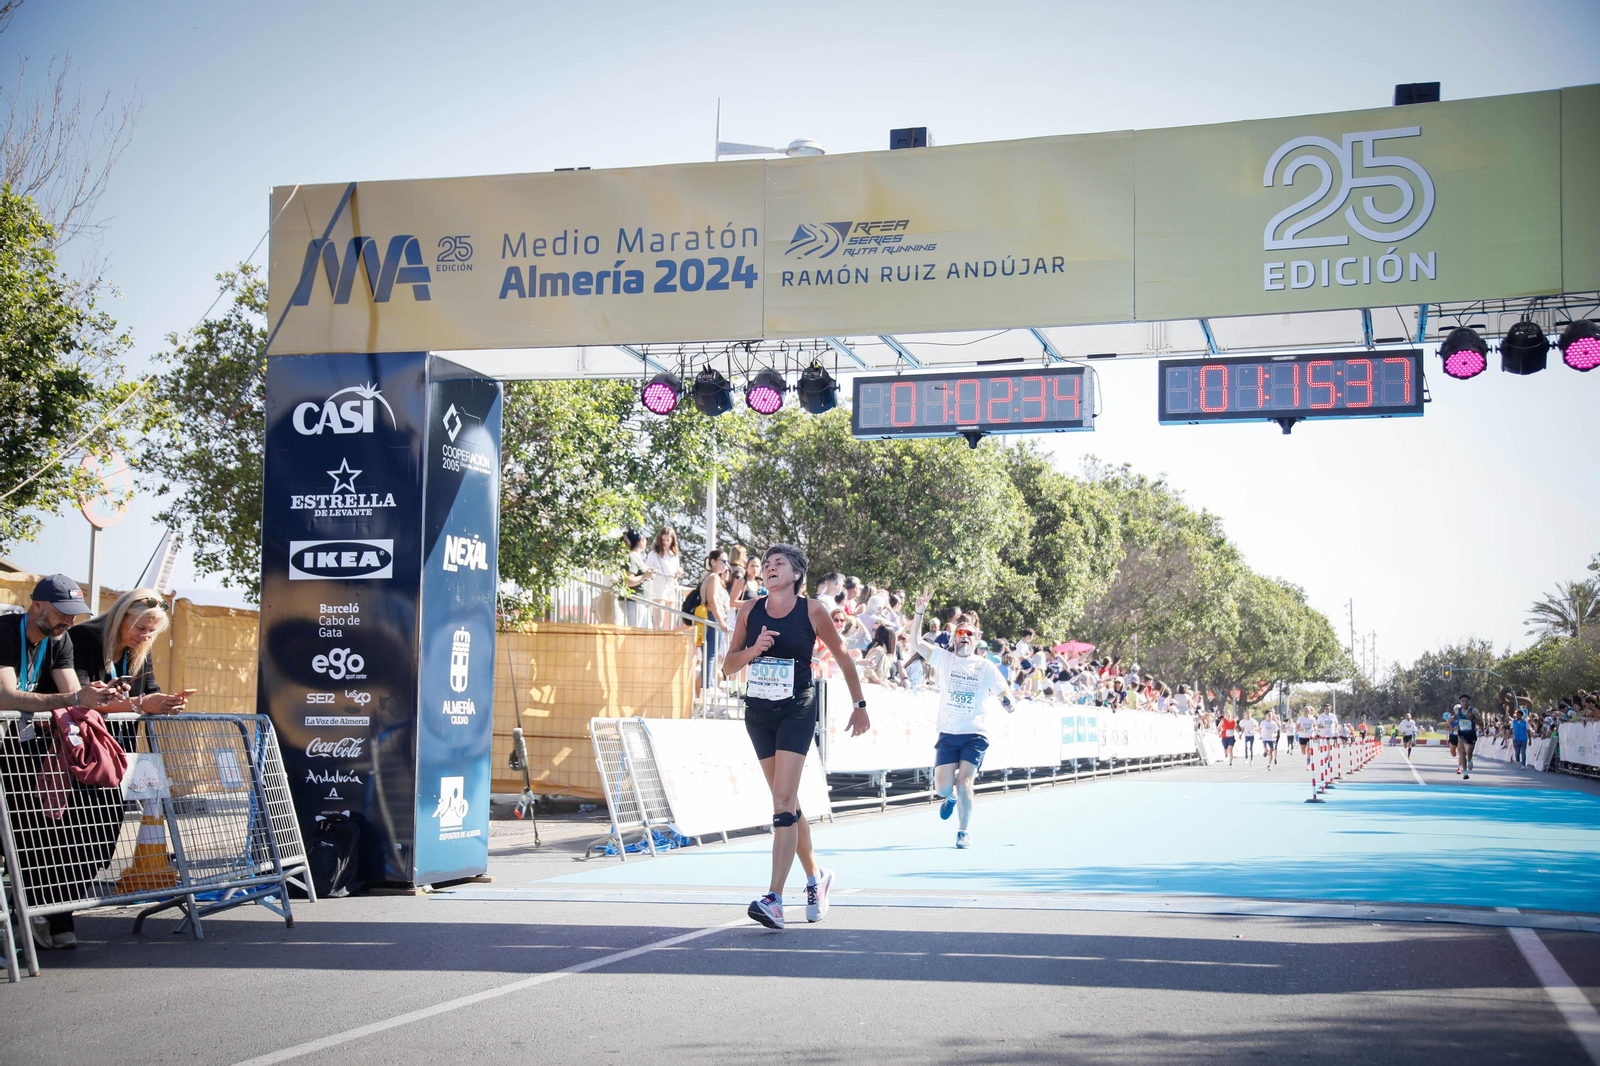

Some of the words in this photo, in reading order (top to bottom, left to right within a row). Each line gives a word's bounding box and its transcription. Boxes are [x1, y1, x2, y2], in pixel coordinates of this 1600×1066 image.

[1263, 126, 1437, 251] 25
[852, 219, 910, 236] RFEA
[436, 235, 474, 262] 25
[501, 228, 601, 260] Medio
[616, 221, 759, 255] Maratón
[847, 234, 905, 247] SERIES
[842, 247, 879, 258] RUTA
[881, 243, 938, 256] RUNNING
[436, 262, 473, 272] EDICIÓN
[781, 264, 869, 287] RAMÓN
[880, 264, 936, 283] RUIZ
[946, 254, 1065, 280] ANDÚJAR
[1263, 246, 1438, 291] EDICIÓN
[498, 260, 645, 300] Almería
[653, 255, 759, 293] 2024
[1199, 357, 1411, 413] 01:15:37
[890, 375, 1080, 427] 01:02:34
[292, 399, 375, 436] CASI
[442, 444, 490, 469] COOPERACIÓN
[442, 457, 460, 472] 2005
[290, 493, 397, 509] ESTRELLA
[314, 509, 328, 517] DE
[329, 508, 373, 517] LEVANTE
[303, 551, 381, 569] IKEA
[319, 602, 360, 614] Barceló
[318, 614, 346, 626] Cabo
[347, 614, 361, 626] de
[318, 627, 343, 638] Gata
[311, 647, 365, 680] ego
[750, 663, 790, 680] 5070
[442, 697, 477, 715] ALMERÍA
[950, 694, 973, 704] 5592
[330, 717, 339, 725] de
[340, 717, 368, 725] Almería
[450, 715, 469, 725] CIUDAD
[305, 768, 364, 785] Andalucía
